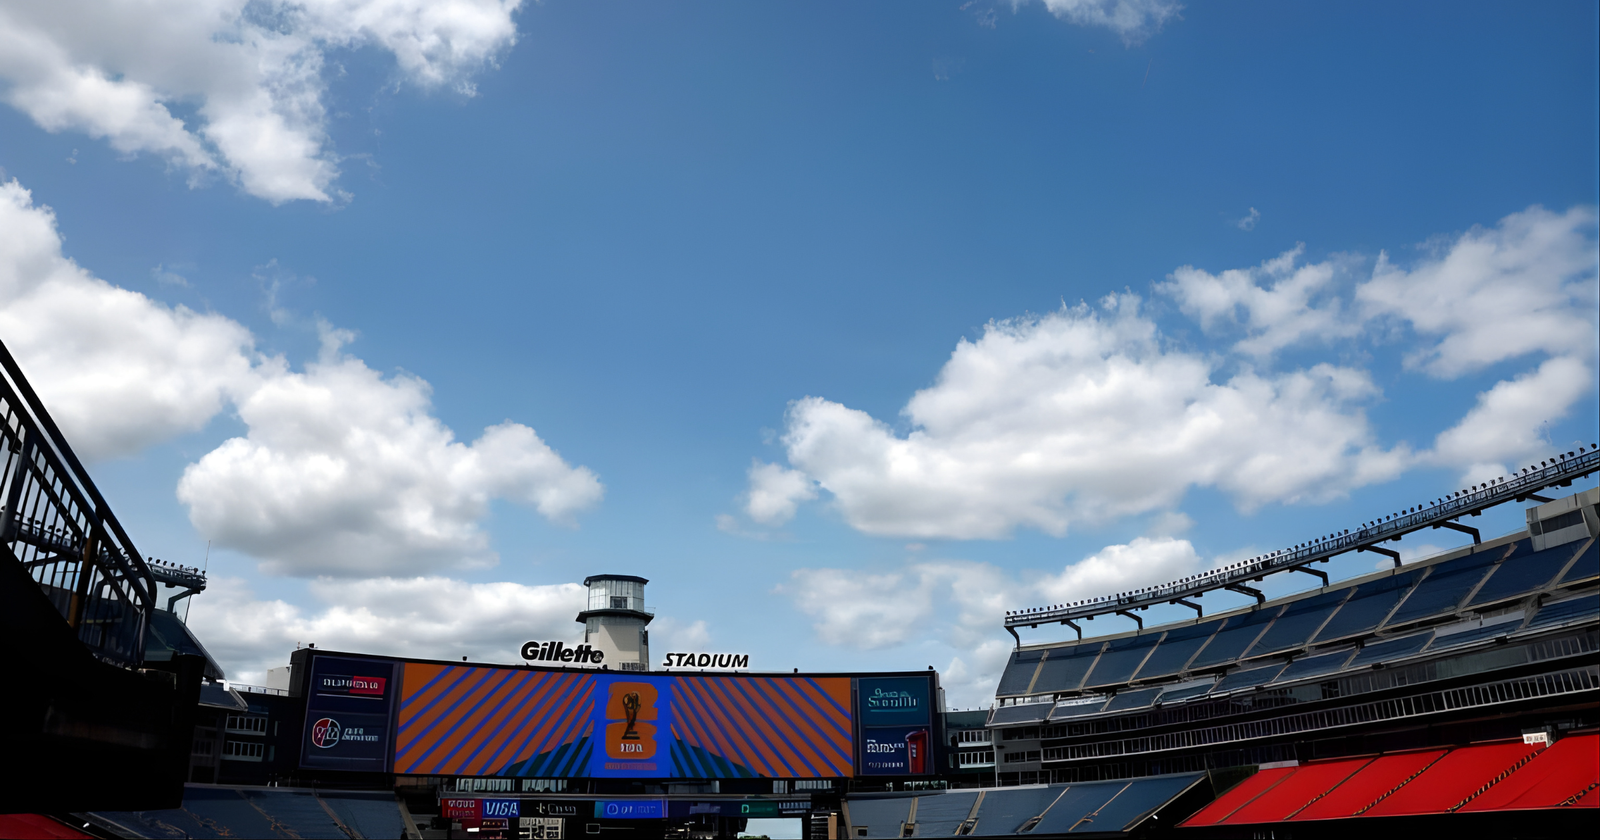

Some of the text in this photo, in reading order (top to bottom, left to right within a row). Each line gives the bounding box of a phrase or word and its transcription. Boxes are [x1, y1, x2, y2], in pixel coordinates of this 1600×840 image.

[521, 641, 749, 668] Gillette STADIUM
[486, 802, 519, 816] VISA
